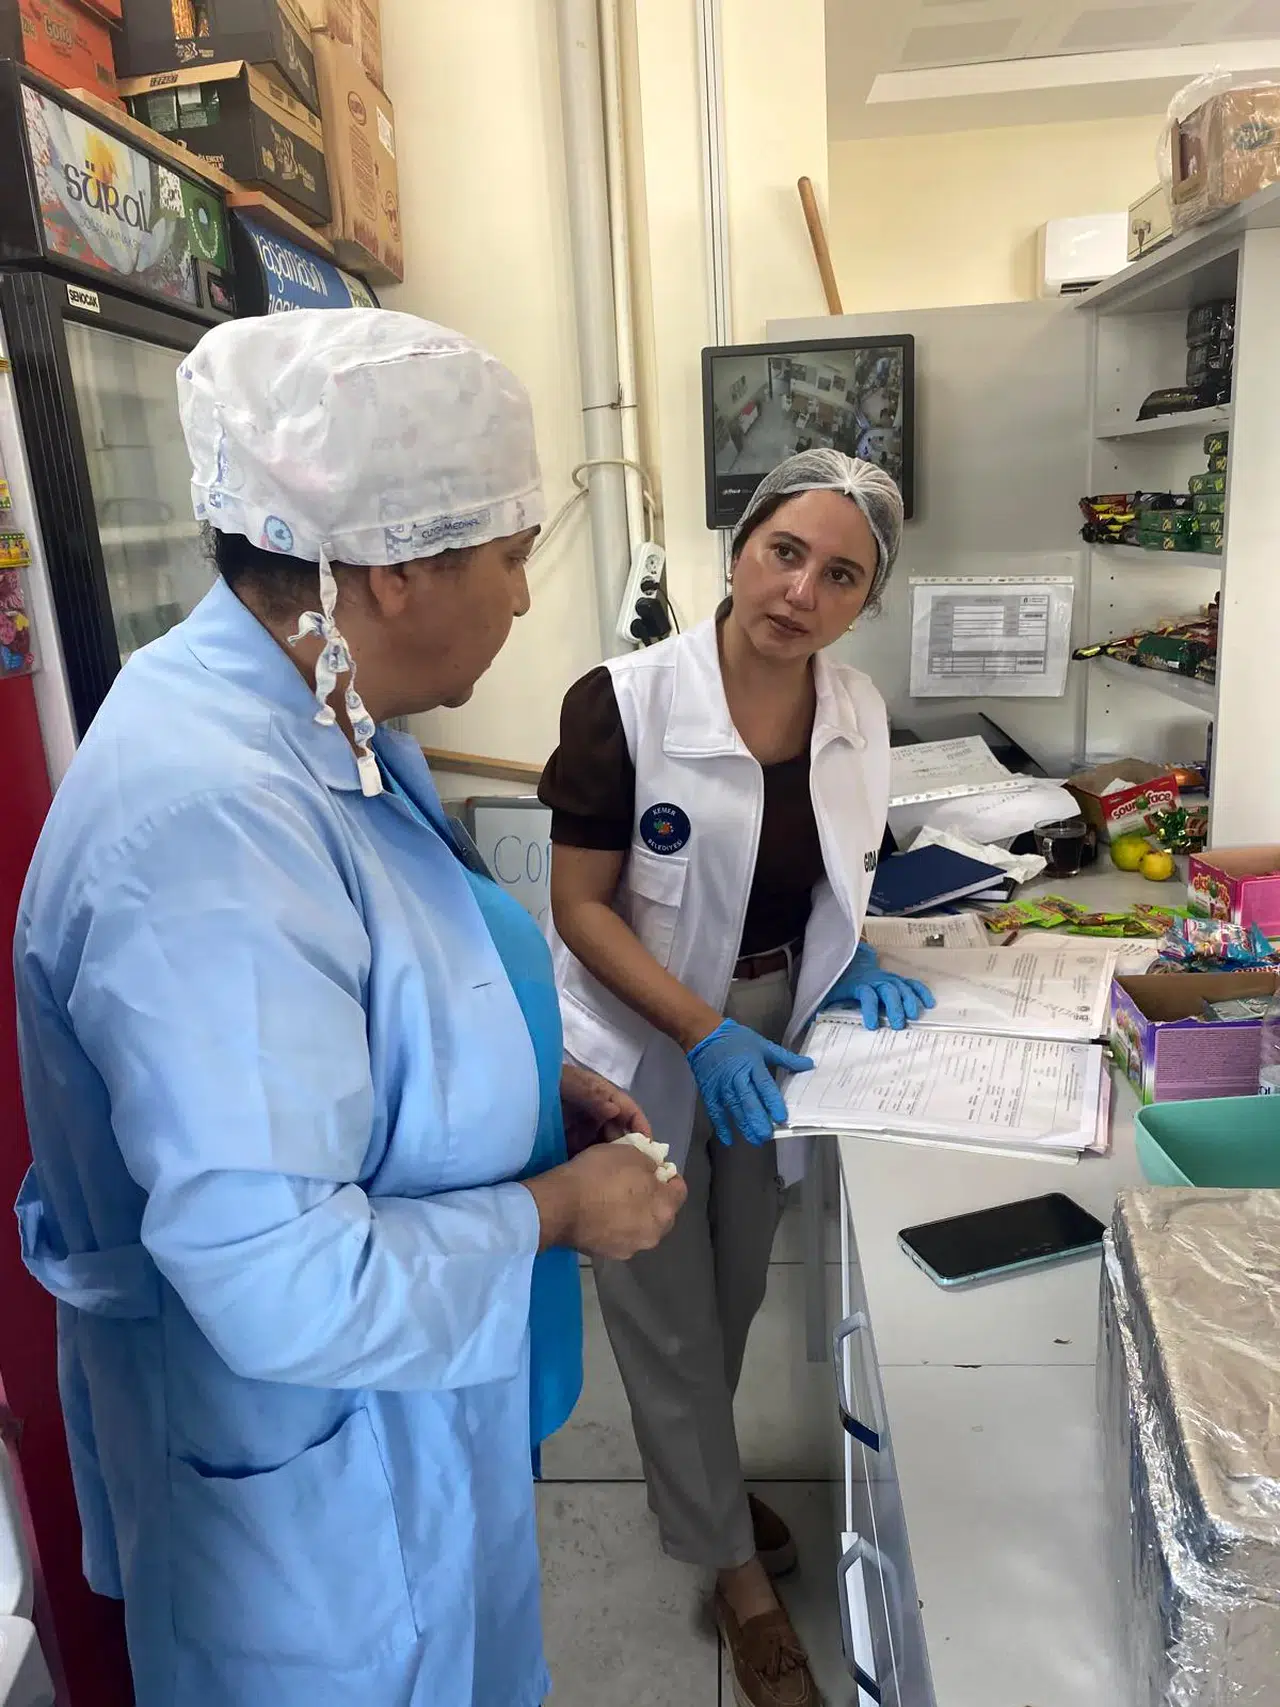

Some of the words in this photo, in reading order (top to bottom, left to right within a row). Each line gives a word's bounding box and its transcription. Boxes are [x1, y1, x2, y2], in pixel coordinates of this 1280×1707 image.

[652, 807, 677, 816] KEMER
[1112, 799, 1136, 820] sour
[1147, 791, 1171, 804] face
